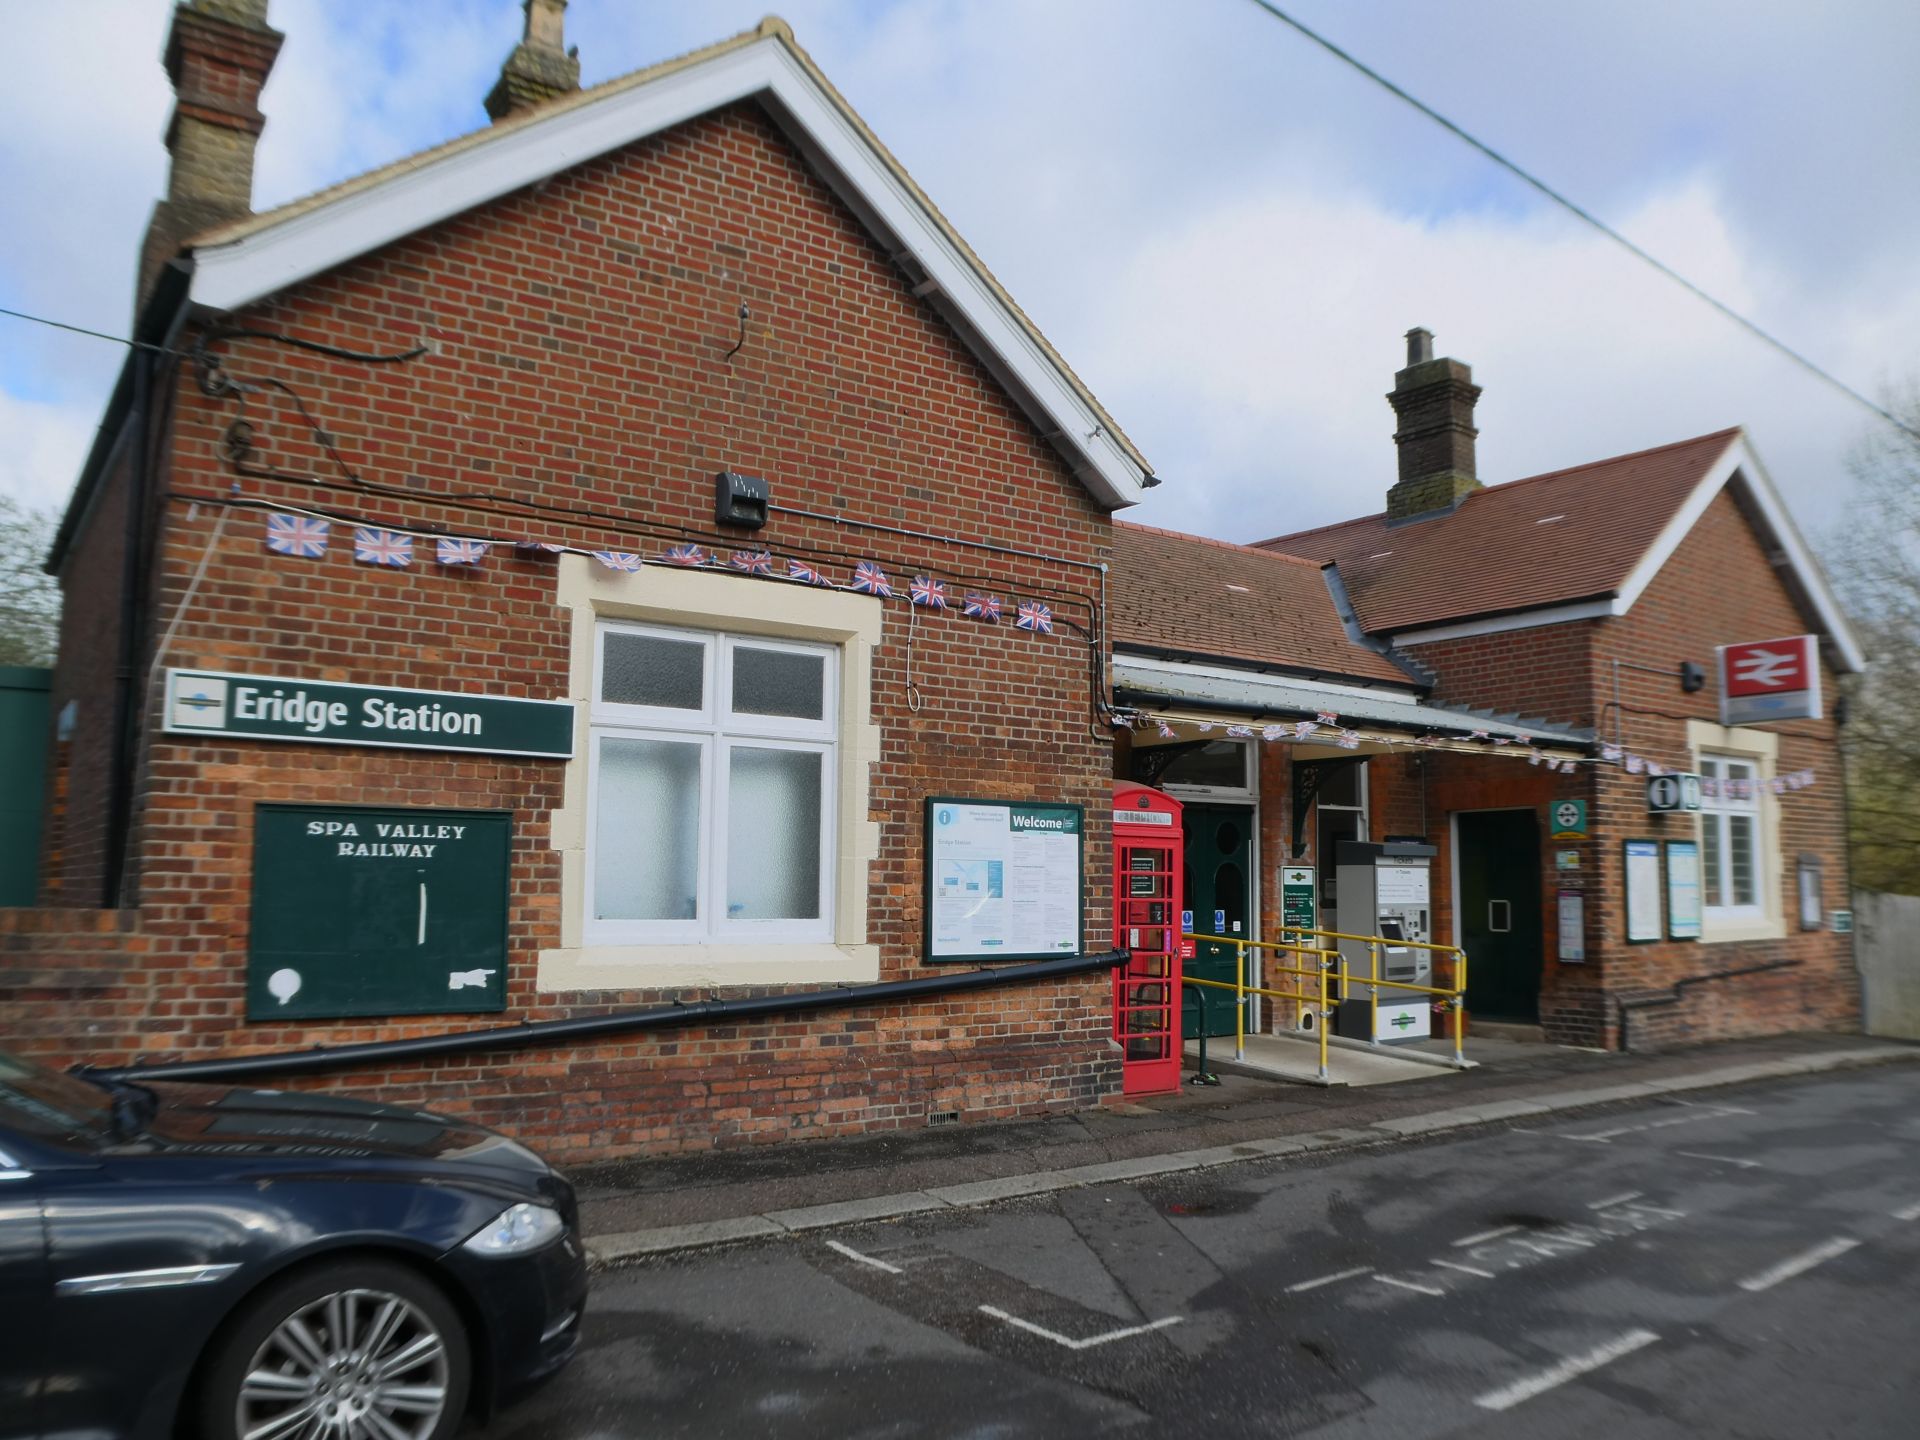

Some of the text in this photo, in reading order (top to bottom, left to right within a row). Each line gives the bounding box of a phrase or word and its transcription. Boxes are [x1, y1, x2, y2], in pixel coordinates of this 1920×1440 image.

[234, 687, 482, 735] Eridge Station
[306, 821, 466, 839] SPA VALLEY
[1013, 815, 1063, 828] Welcome
[337, 842, 437, 858] RAILWAY
